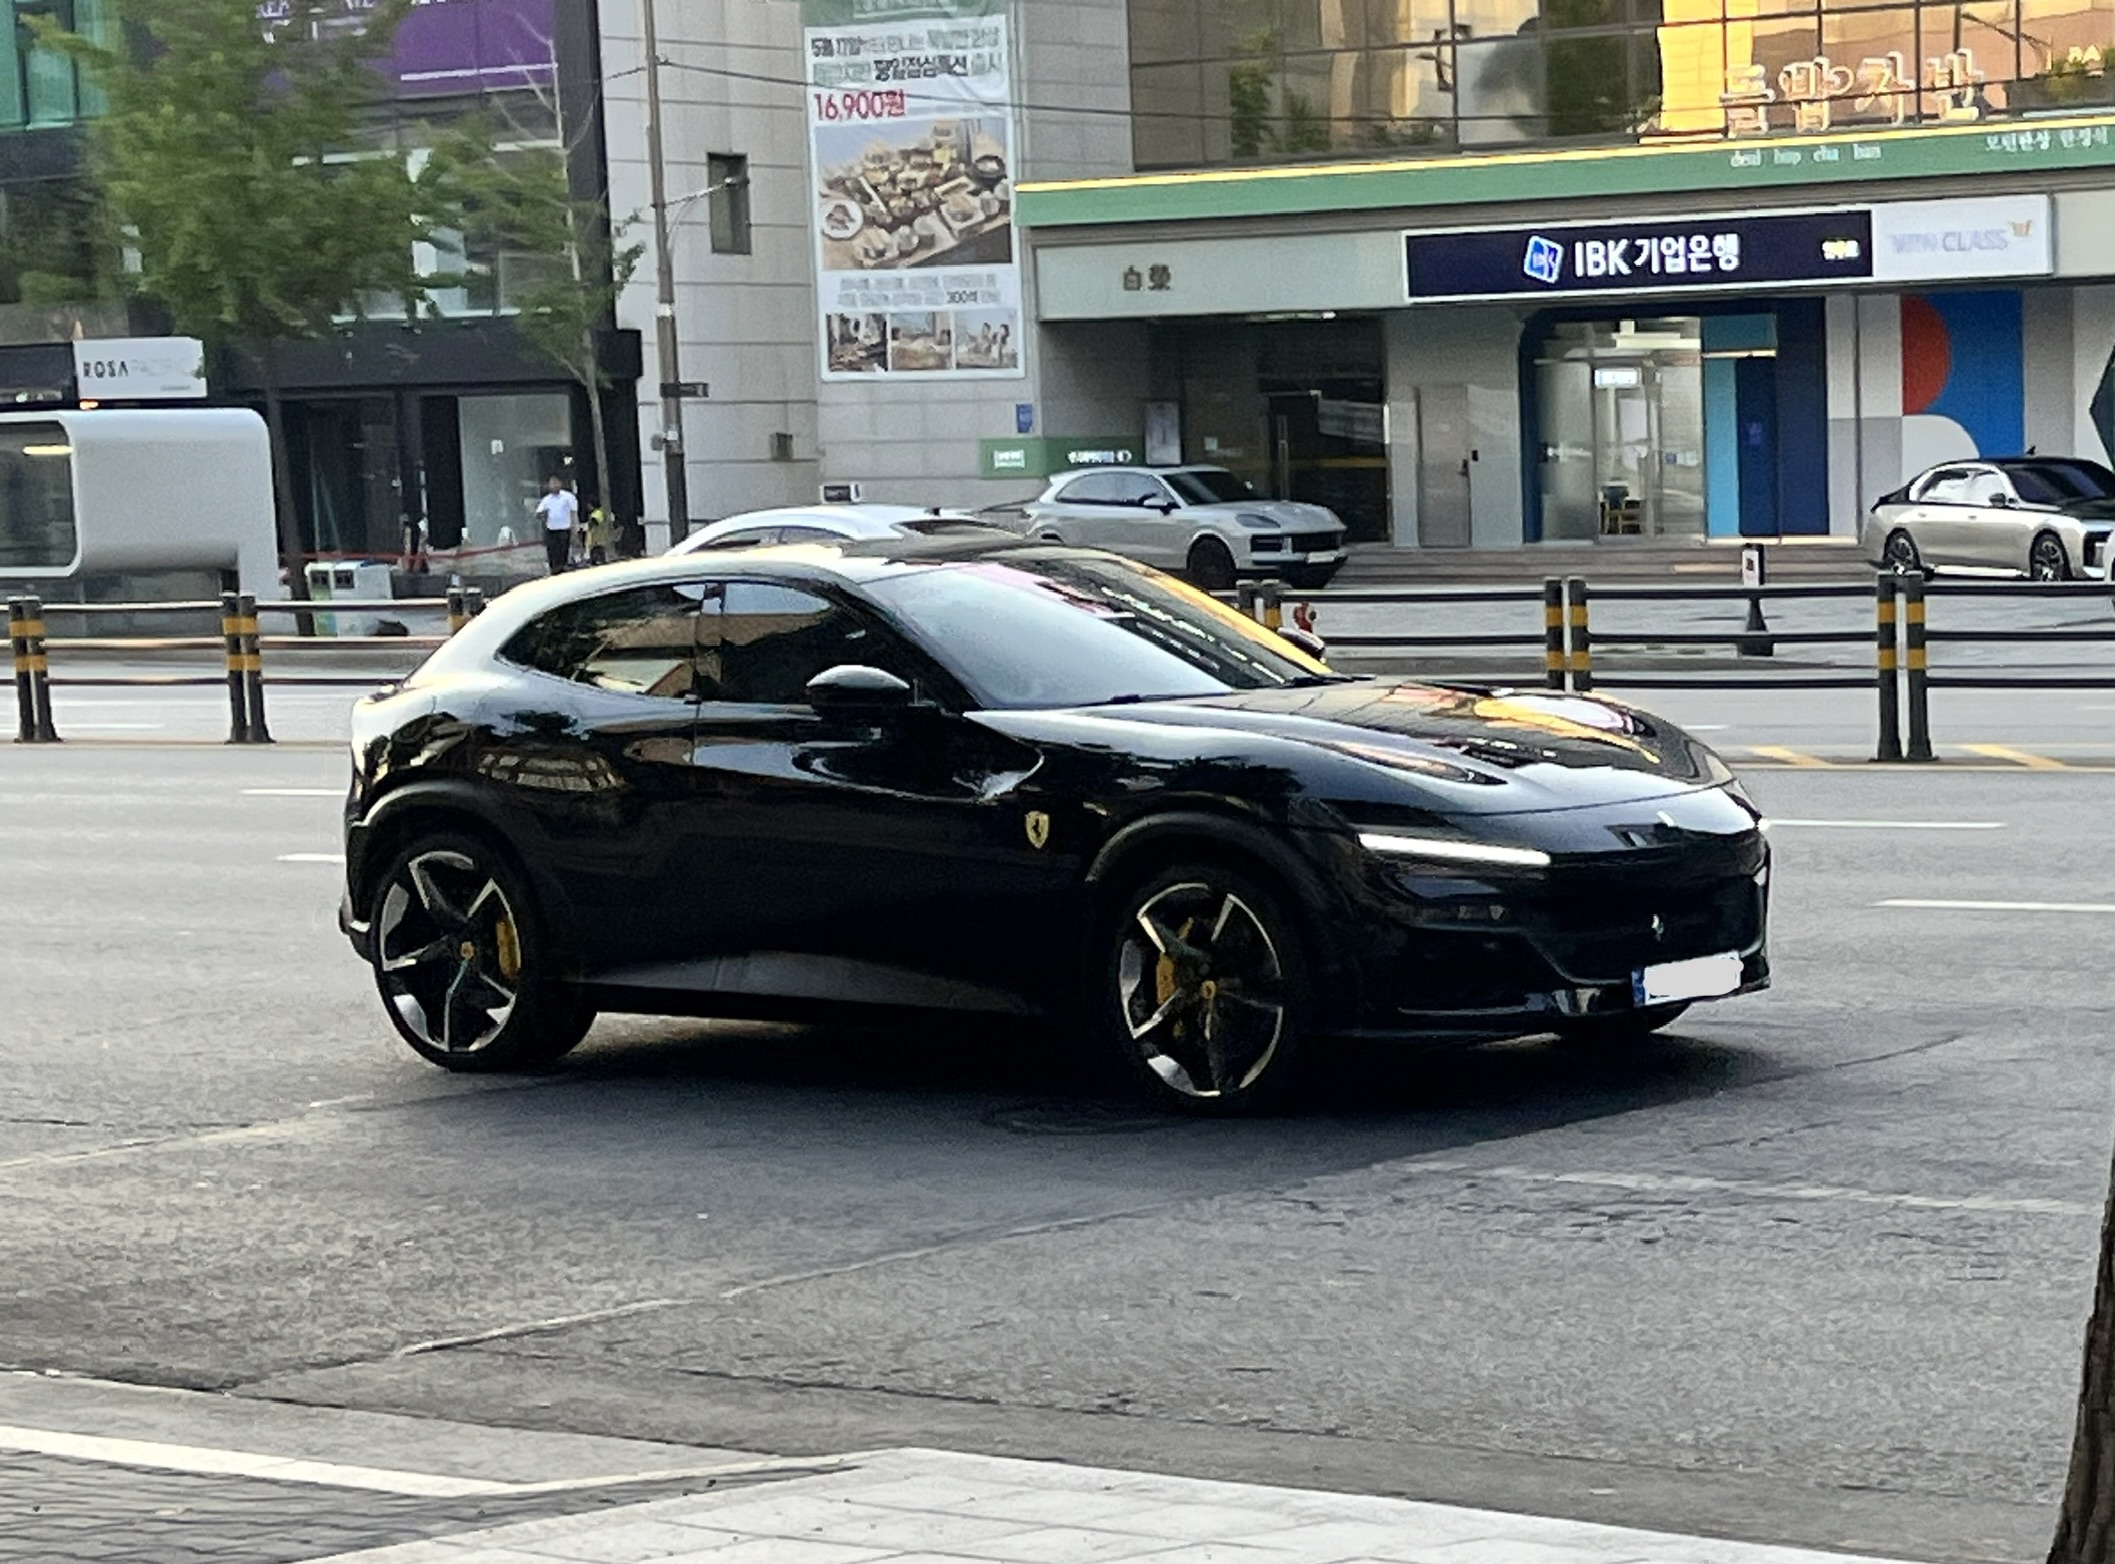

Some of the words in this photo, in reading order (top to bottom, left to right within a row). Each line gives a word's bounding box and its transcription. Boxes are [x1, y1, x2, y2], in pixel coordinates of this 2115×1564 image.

[813, 89, 906, 121] 16,900원
[1575, 238, 1632, 277] IBK
[1634, 233, 1740, 273] 기업은행
[1942, 229, 2008, 252] CLASS
